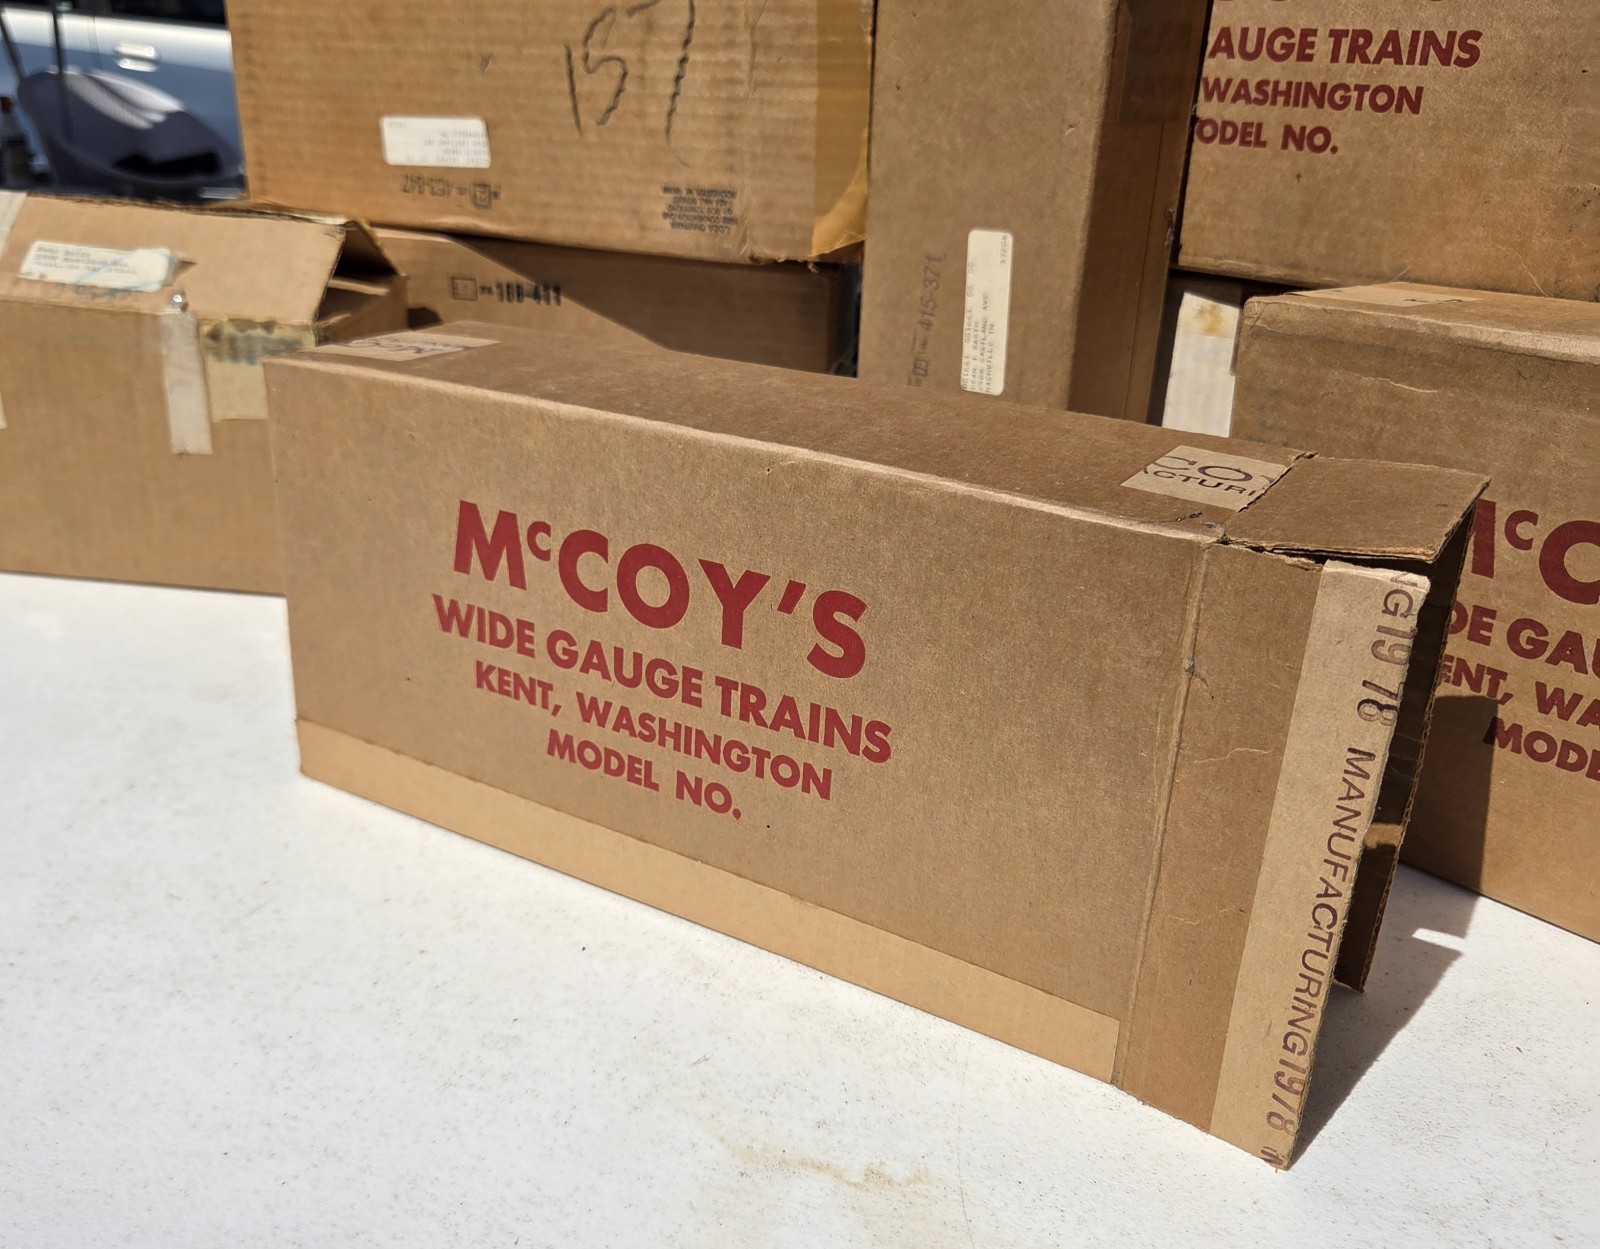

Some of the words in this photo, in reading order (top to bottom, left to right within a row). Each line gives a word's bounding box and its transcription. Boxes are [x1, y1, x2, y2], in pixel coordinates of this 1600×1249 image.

[1208, 27, 1318, 63] AUGE
[1328, 28, 1483, 68] TRAINS
[1201, 77, 1424, 115] WASHINGTON
[1195, 118, 1267, 148] ODEL
[1280, 124, 1338, 154] NO.
[432, 593, 536, 658] WIDE
[546, 629, 703, 708] GAUGE
[714, 675, 892, 763] TRAINS
[475, 660, 562, 717] KENT,
[576, 691, 832, 800] WASHINGTON
[547, 729, 660, 792] MODEL
[675, 770, 742, 821] NO.
